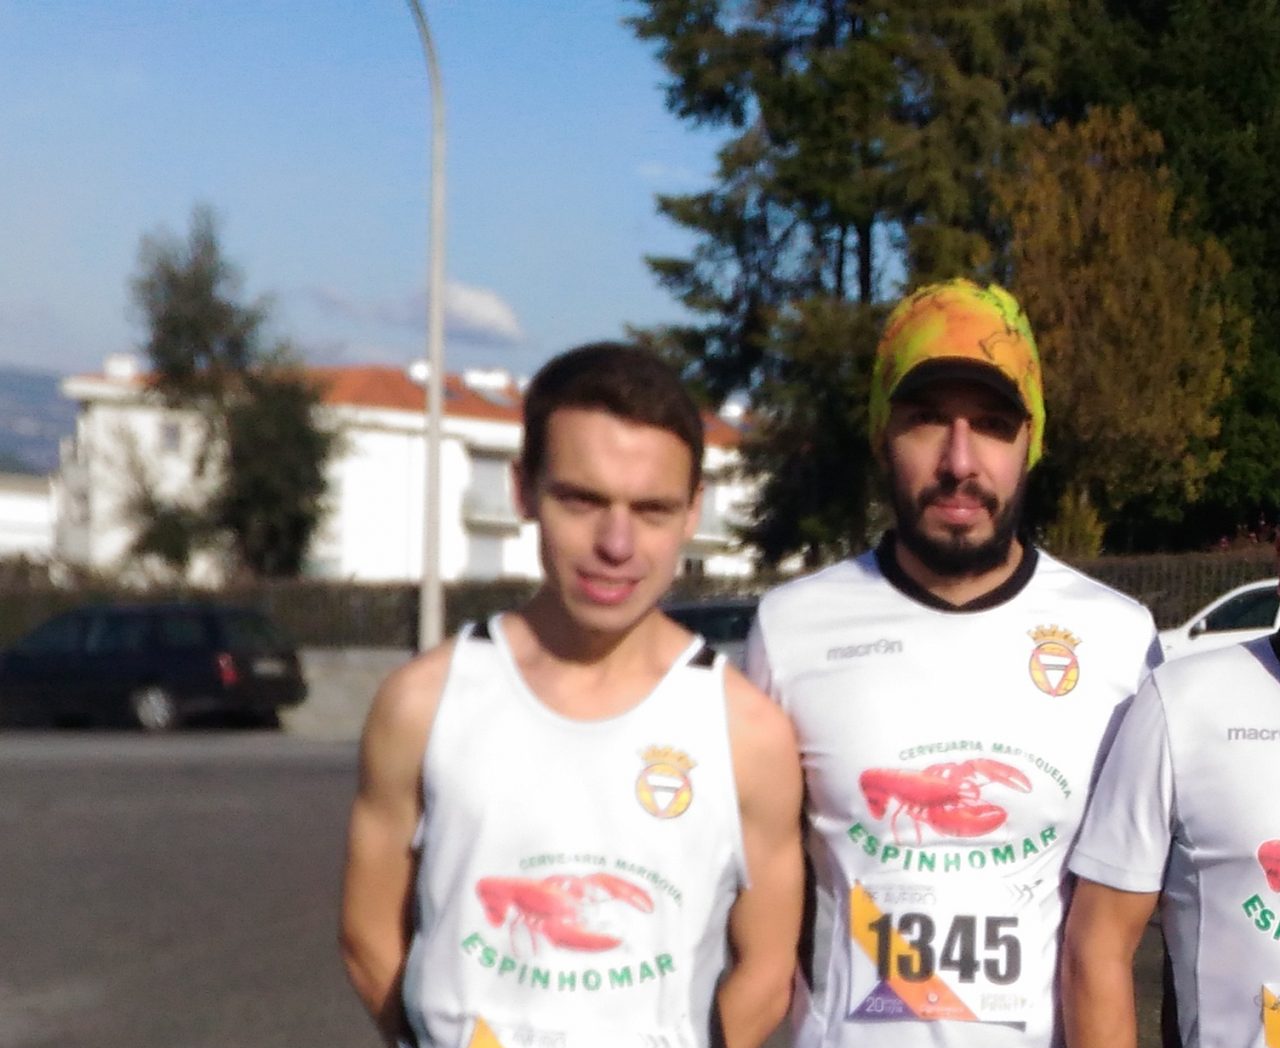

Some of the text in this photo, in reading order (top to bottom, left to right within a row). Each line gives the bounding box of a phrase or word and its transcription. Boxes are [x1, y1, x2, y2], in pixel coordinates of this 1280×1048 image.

[899, 740, 983, 761] CERVEJARIA
[519, 850, 608, 870] CERVEARIA
[847, 821, 1058, 873] ESPINHOMAR
[461, 930, 677, 991] ESPINHOMAR
[868, 912, 1022, 985] 1345
